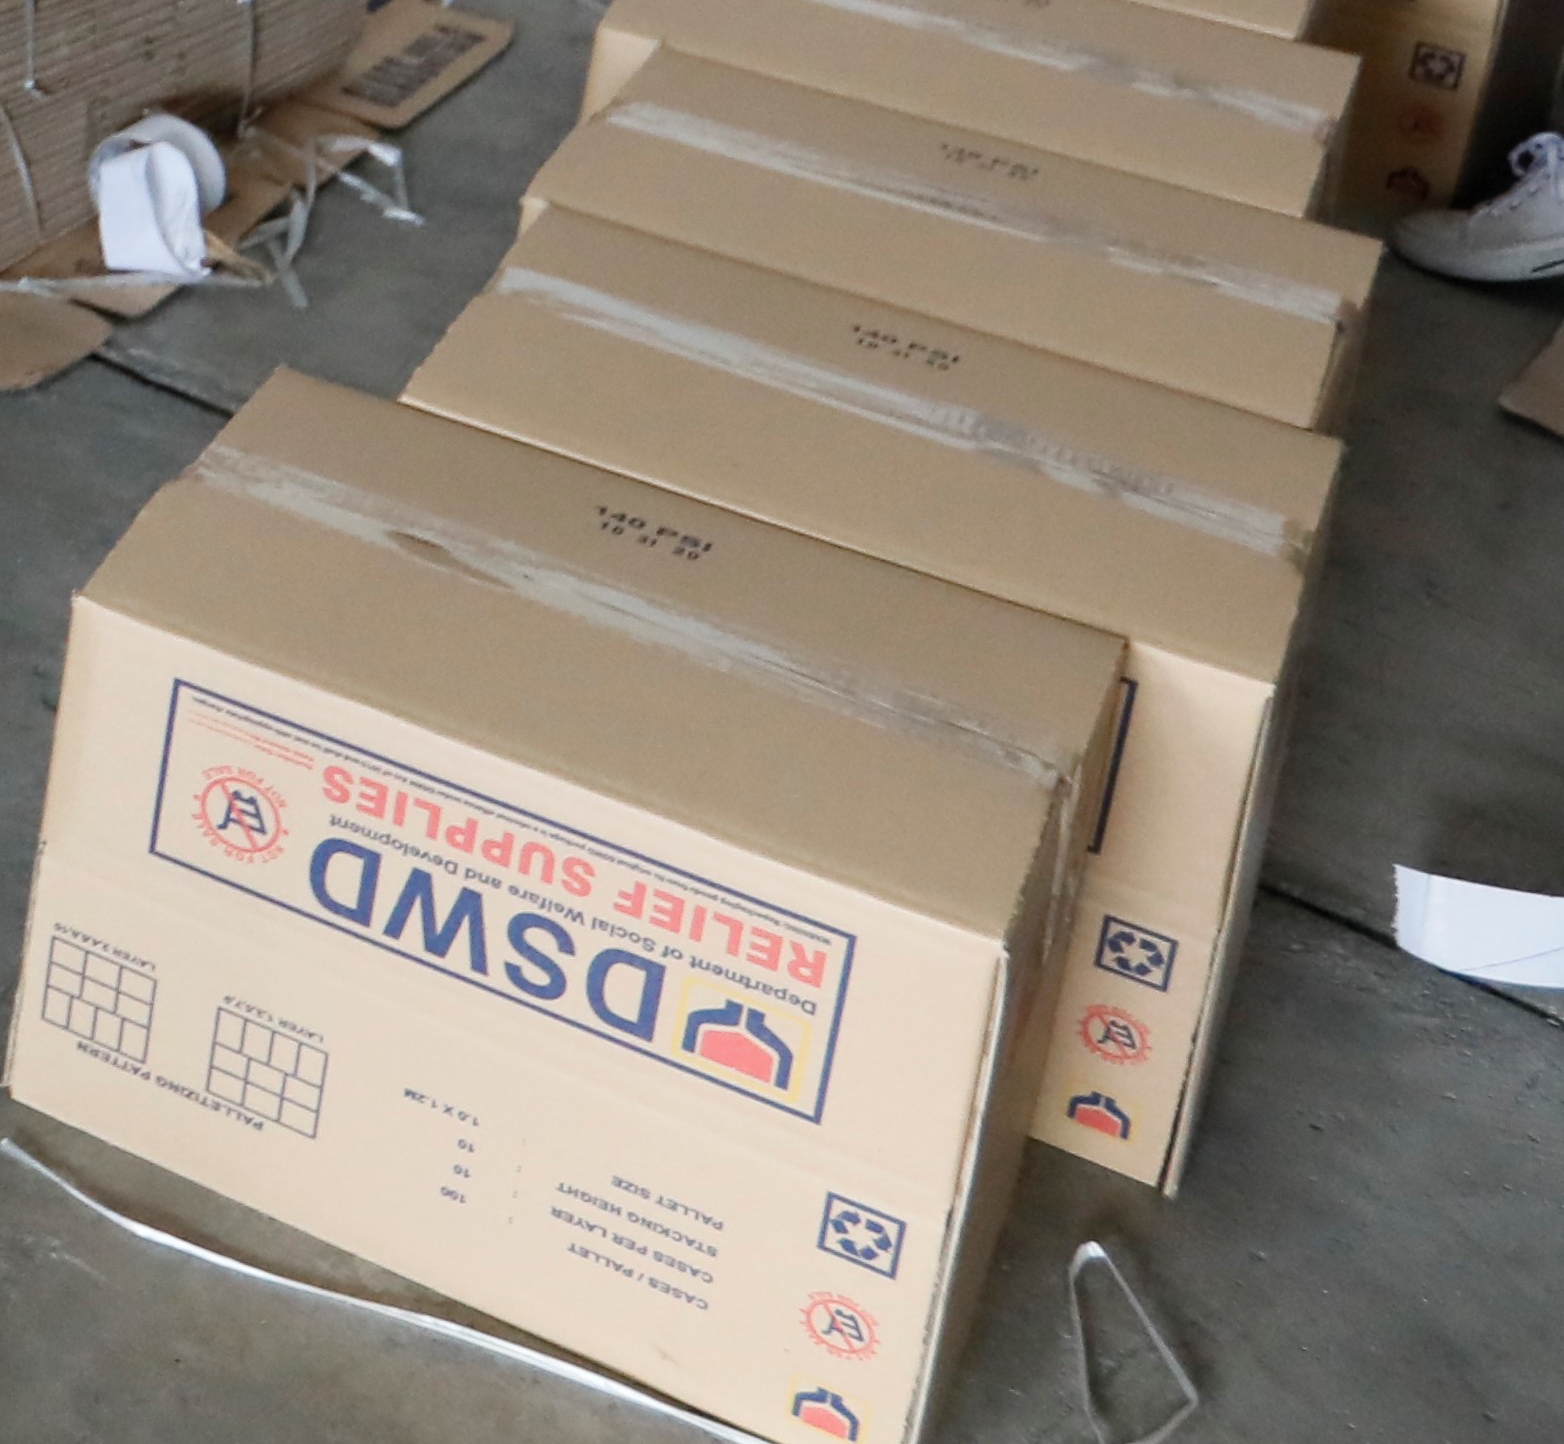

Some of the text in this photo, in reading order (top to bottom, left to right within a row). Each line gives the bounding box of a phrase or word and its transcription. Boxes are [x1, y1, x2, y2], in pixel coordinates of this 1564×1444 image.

[321, 765, 597, 898] SUPPLIES
[309, 837, 666, 1042] DSWD
[329, 813, 817, 1016] Department of Social Welfare and Development
[613, 880, 827, 989] RELIEF
[76, 1041, 265, 1132] PALLETIZING PATTERN
[550, 1206, 716, 1284] CASES PER LAYER
[556, 1181, 718, 1258] STACKING HEIGHT
[610, 1174, 724, 1232] PALLET SIZE
[567, 1242, 711, 1311] CASES PALLET
